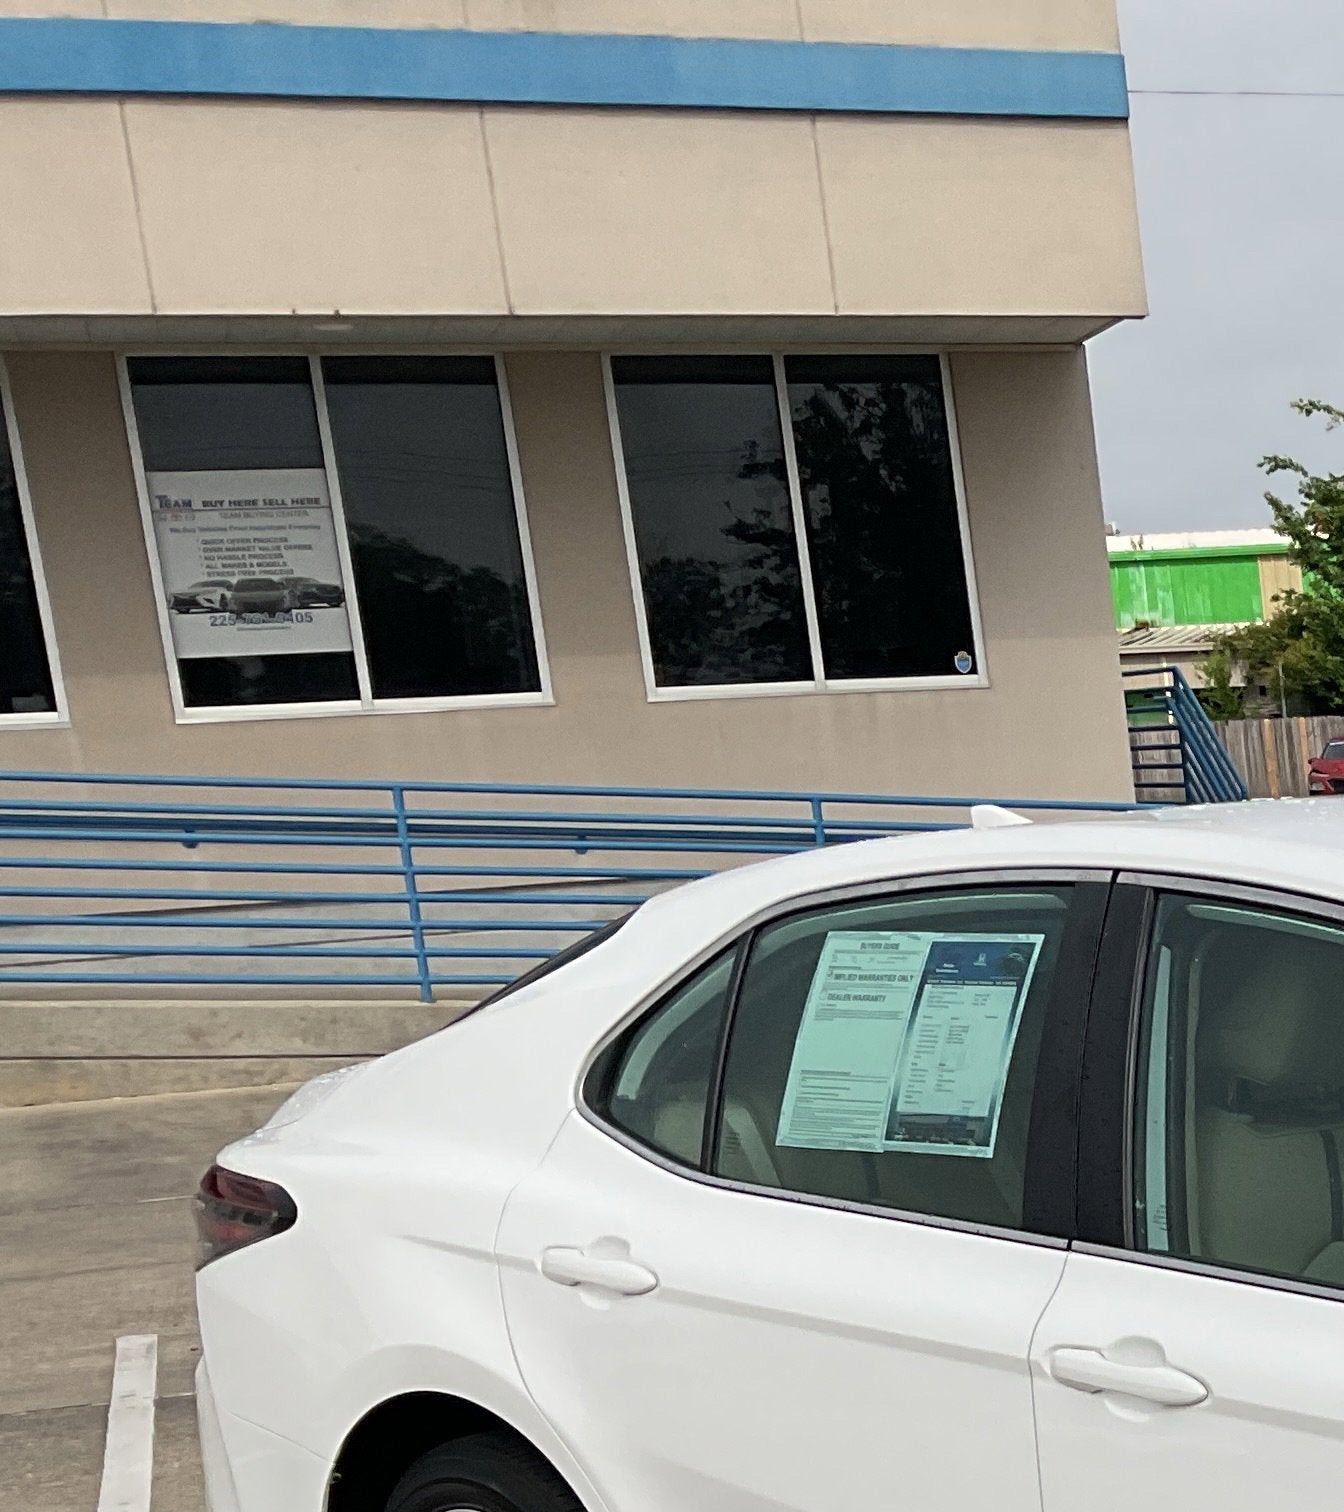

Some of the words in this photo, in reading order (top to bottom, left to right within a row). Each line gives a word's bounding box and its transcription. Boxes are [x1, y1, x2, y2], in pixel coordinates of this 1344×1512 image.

[155, 494, 192, 509] TEAM
[202, 499, 225, 508] BUY
[228, 498, 258, 507] HERE
[262, 498, 288, 507] SELL
[291, 497, 321, 506] HERE
